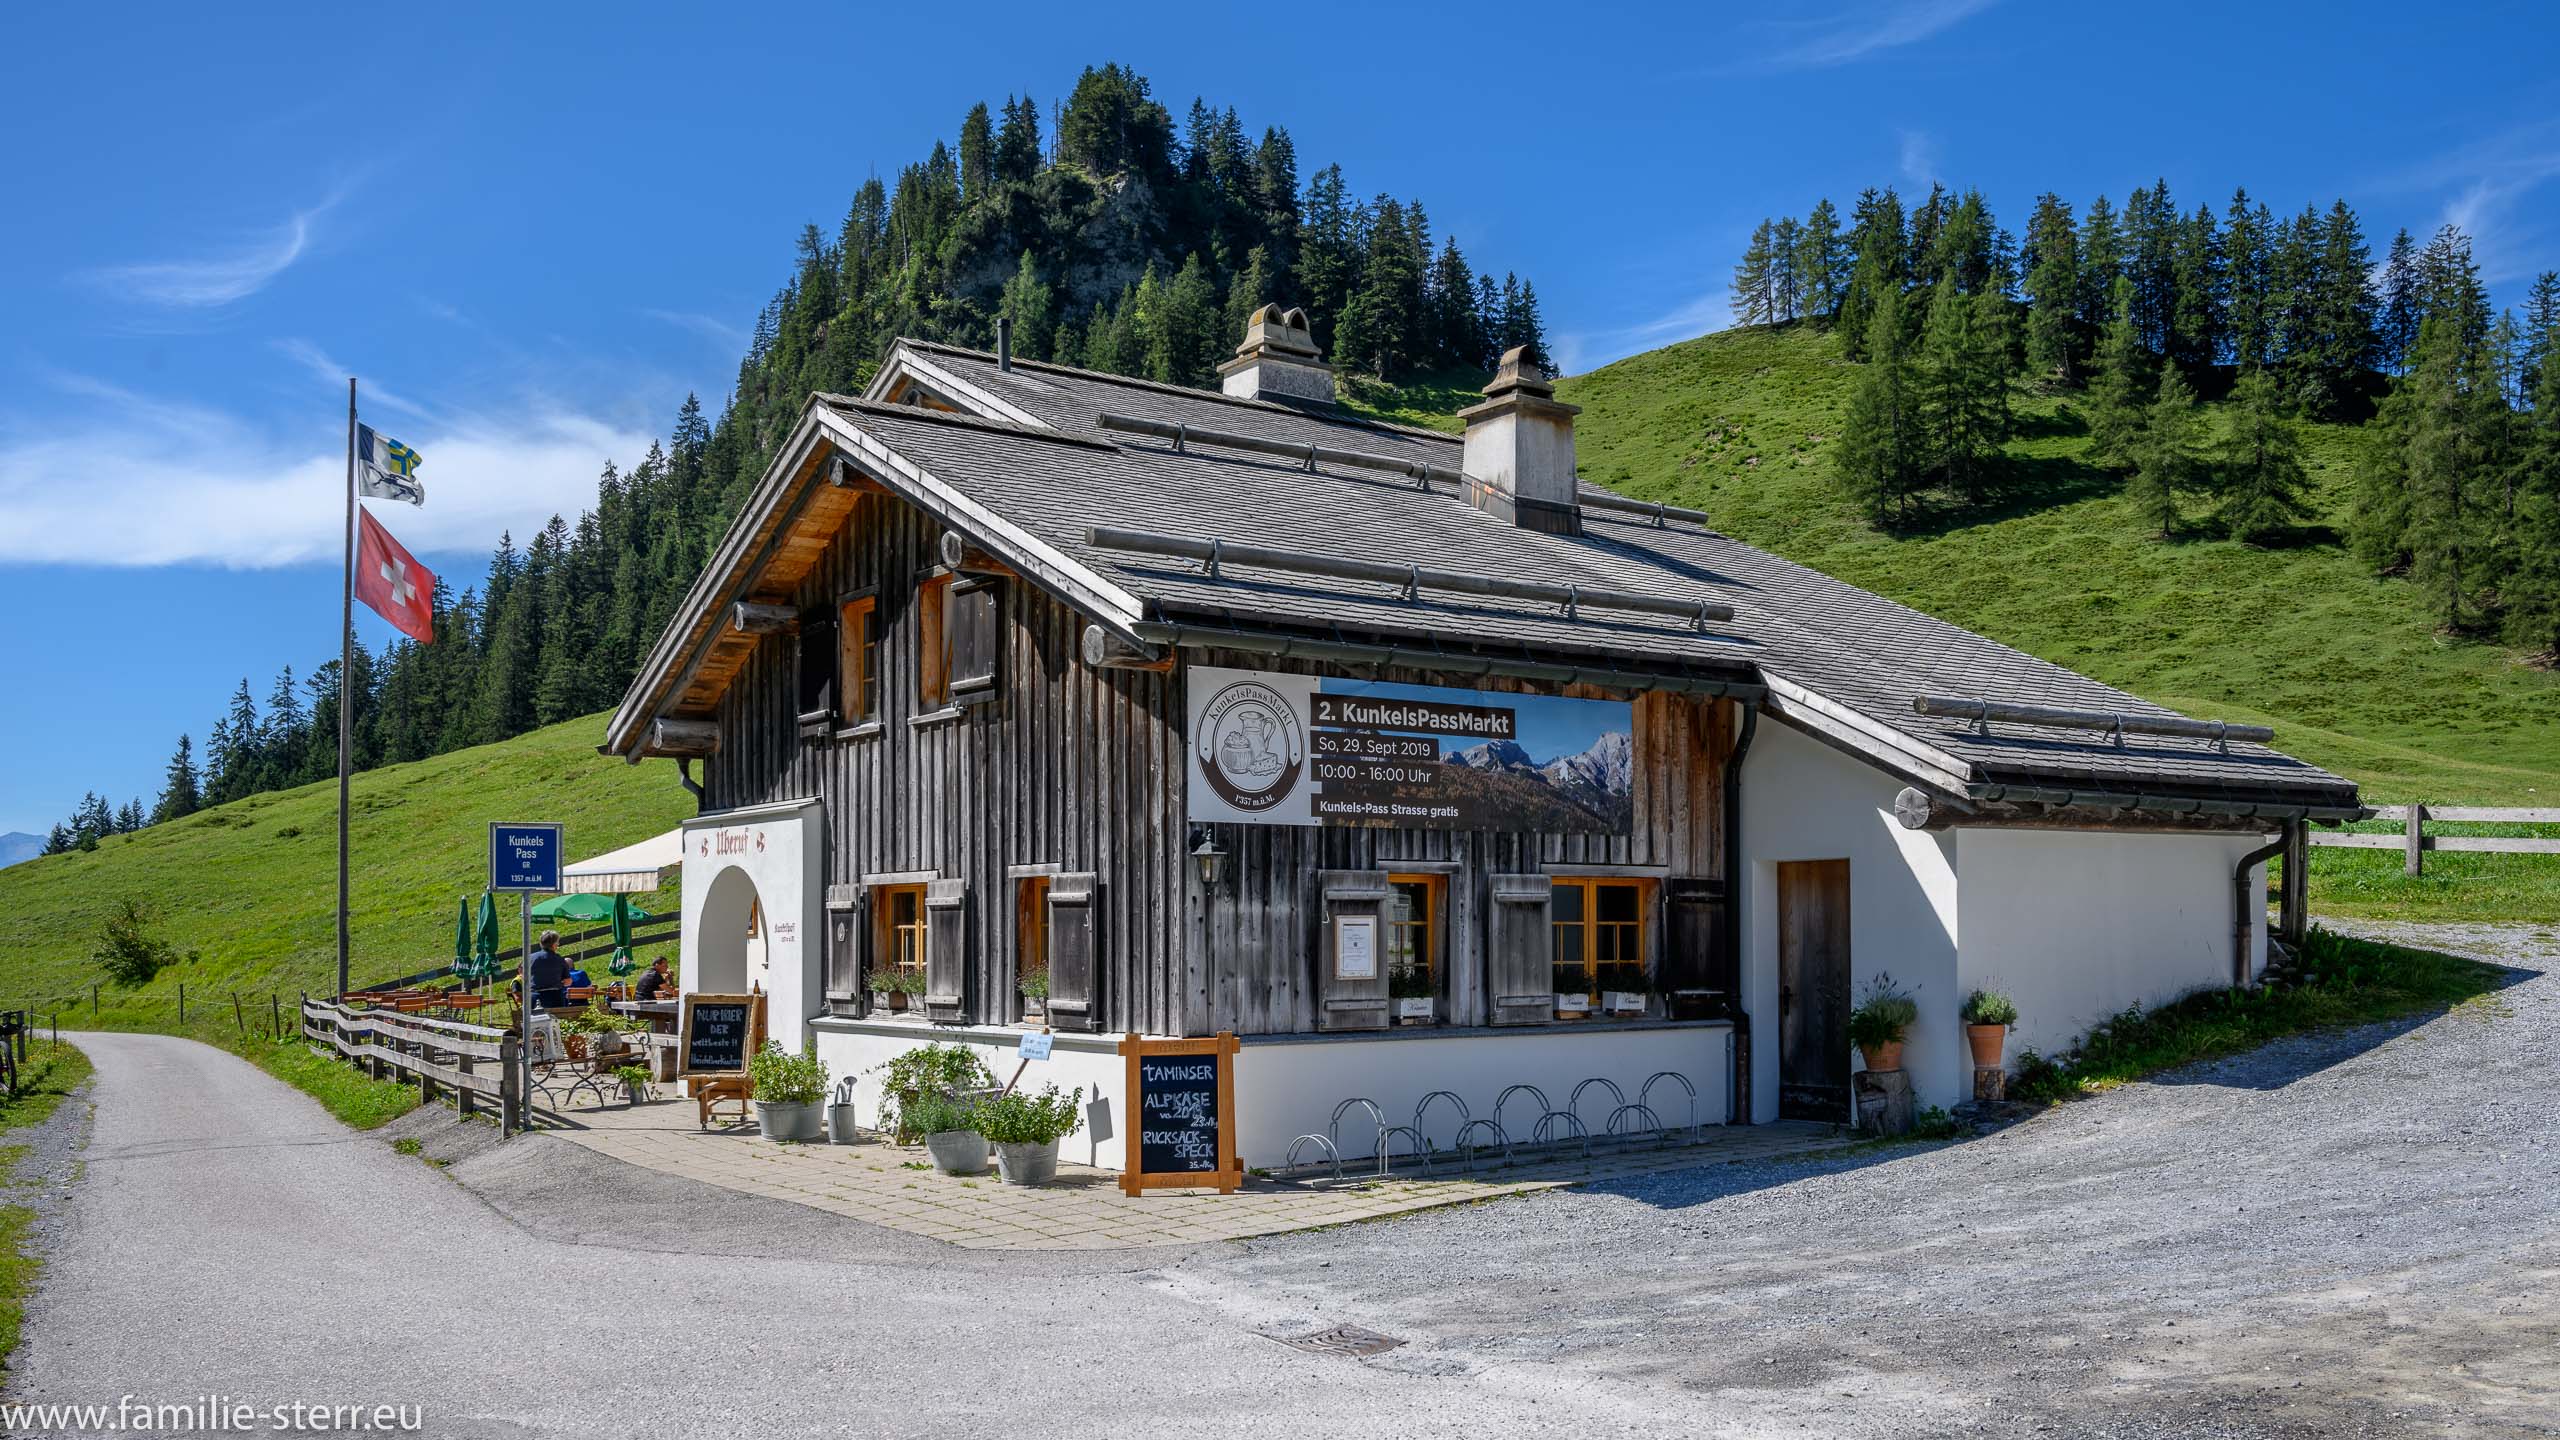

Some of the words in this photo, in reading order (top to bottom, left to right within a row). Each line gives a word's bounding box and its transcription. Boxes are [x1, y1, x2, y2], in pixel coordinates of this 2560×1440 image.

[1209, 688, 1293, 727] KunkelsPassMarkt
[1319, 701, 1336, 721] 2.
[1343, 703, 1509, 734] KunkelsPassMarkt
[1319, 737, 1339, 753] So,
[1343, 738, 1363, 753] 29.
[1367, 740, 1397, 757] Sept
[1401, 742, 1431, 757] 2019
[1319, 765, 1356, 779] 10:00
[1370, 767, 1404, 782] 16:00
[1408, 769, 1432, 783] Uhr
[1319, 800, 1388, 814] Kunkels-Pass
[1391, 804, 1427, 816] Strasse
[1430, 806, 1459, 818] gratis
[509, 835, 544, 846] Kunkels
[516, 848, 536, 858] Pass
[696, 1009, 719, 1022] NUR
[720, 1008, 743, 1022] HIER
[710, 1024, 729, 1035] DER
[1145, 1091, 1211, 1108] ALPKÄSE
[1174, 1143, 1214, 1158] SPECK
